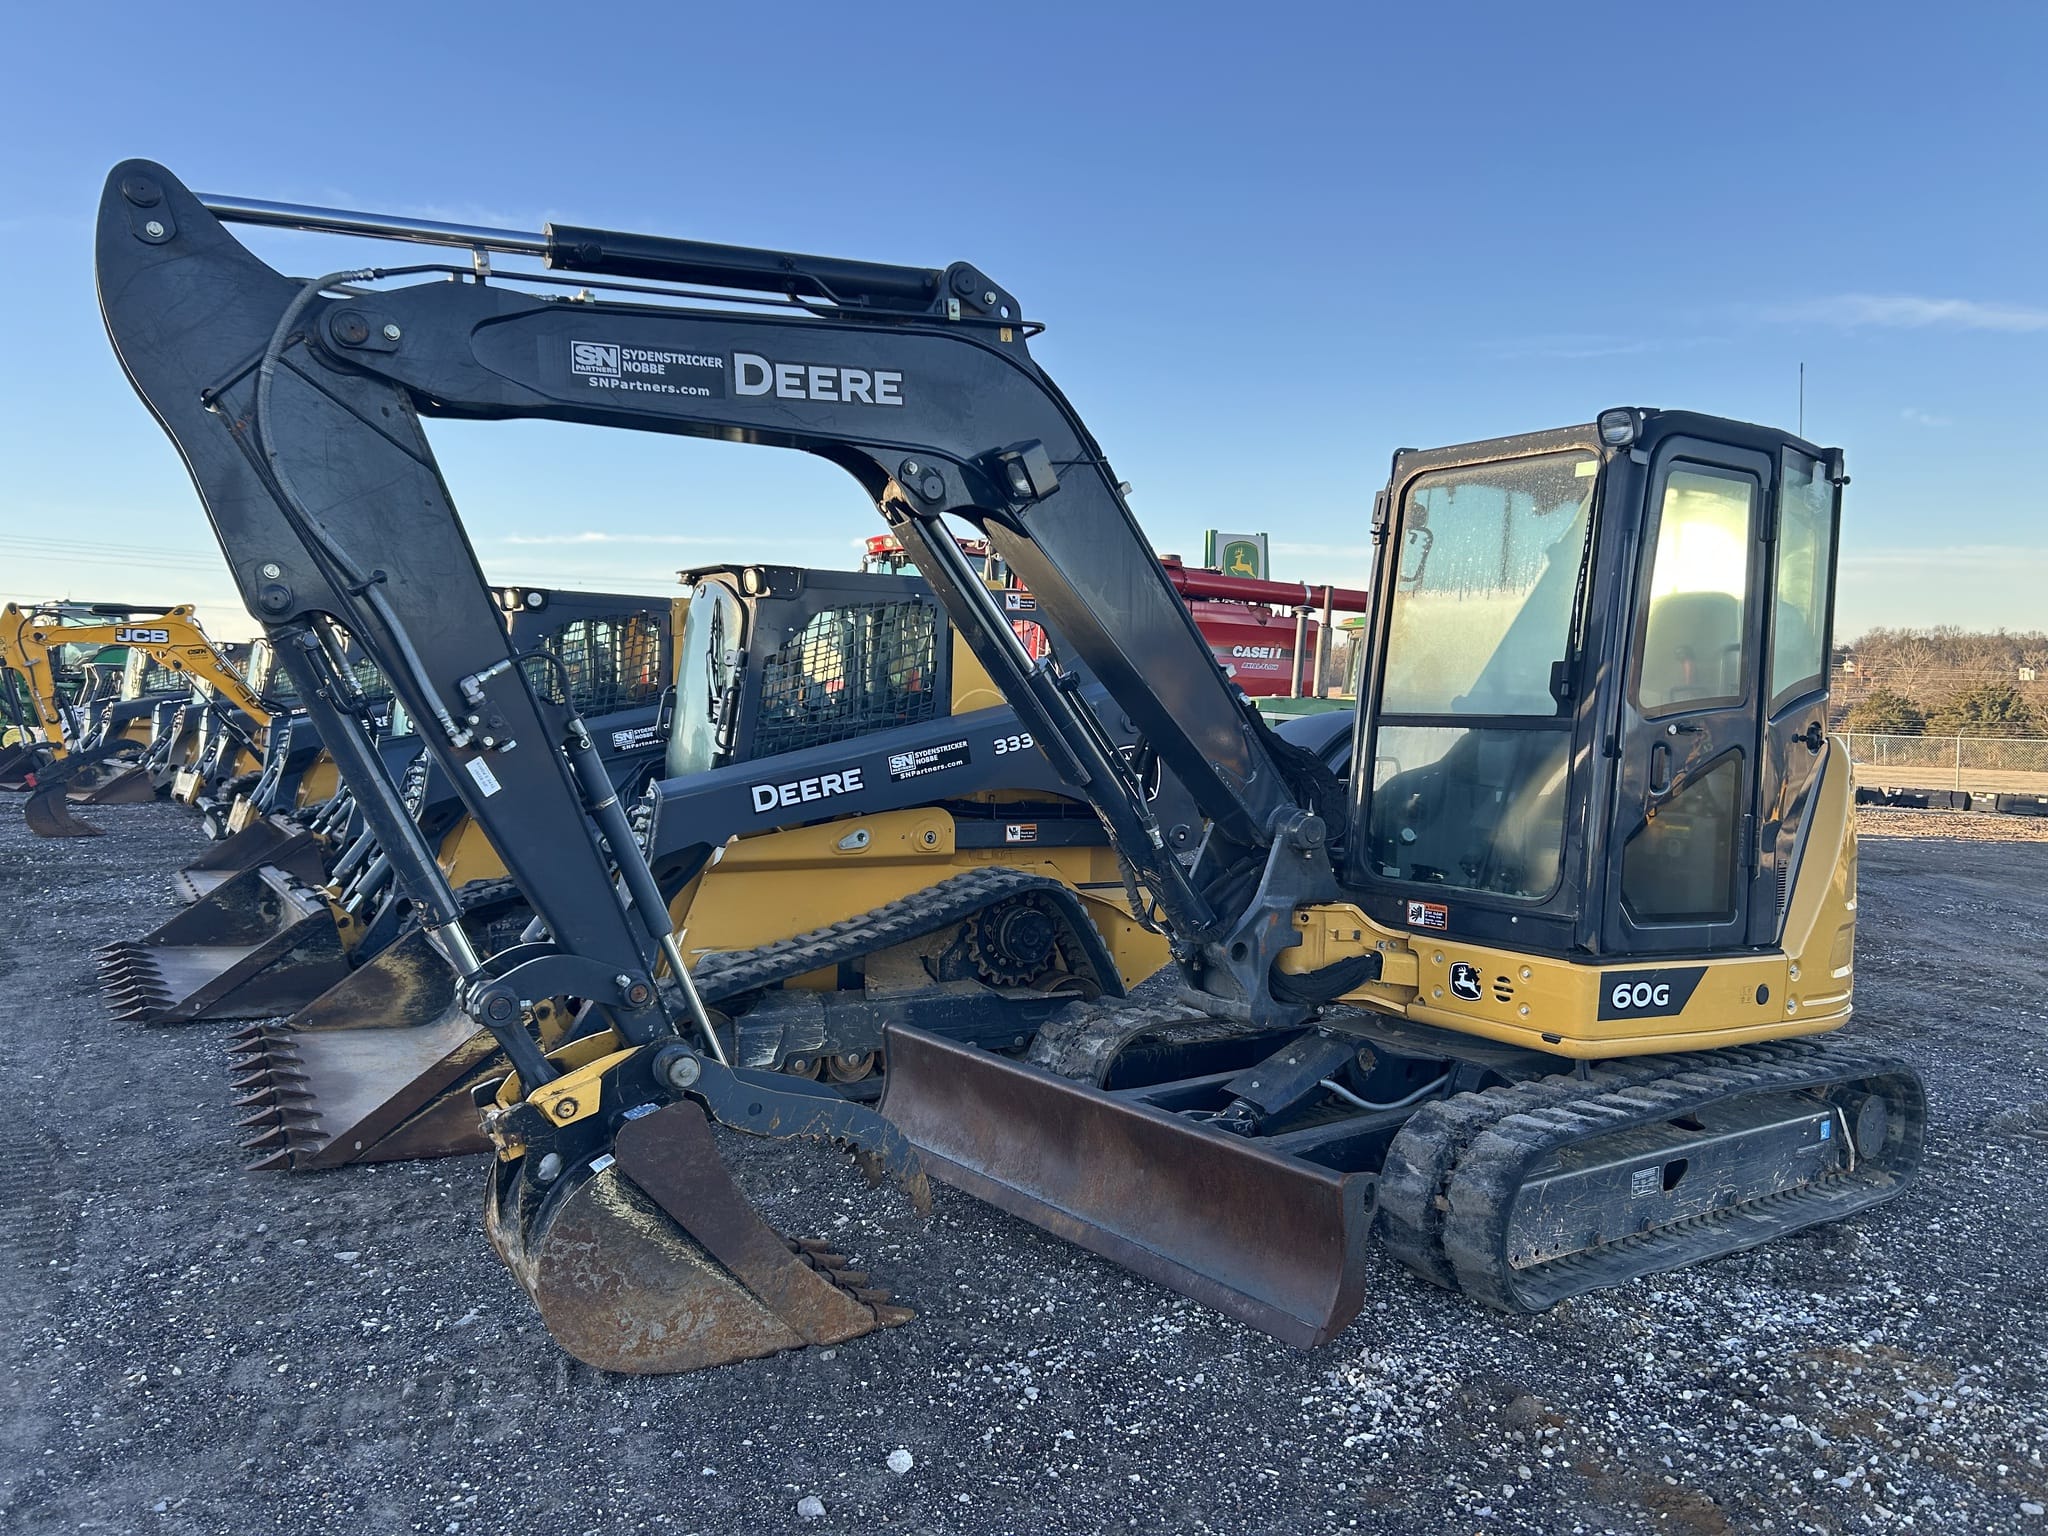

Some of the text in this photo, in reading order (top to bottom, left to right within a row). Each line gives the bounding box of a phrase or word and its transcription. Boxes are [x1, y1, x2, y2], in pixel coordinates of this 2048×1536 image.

[575, 345, 617, 367] SN
[622, 349, 723, 368] SYDENSTRICKER
[575, 364, 617, 374] PARTNERS
[623, 360, 665, 375] NOBBE
[589, 377, 710, 396] SNPartners.com
[733, 352, 903, 405] DEERE
[116, 628, 169, 643] JCB
[1232, 645, 1269, 658] CASE
[914, 740, 969, 759] SYDENSTRICKER
[993, 732, 1034, 755] 333
[891, 754, 914, 769] SN
[916, 754, 939, 766] NOBBE
[900, 760, 963, 780] SNPartners.com
[751, 768, 864, 813] DEERE
[1612, 982, 1670, 1009] 60G
